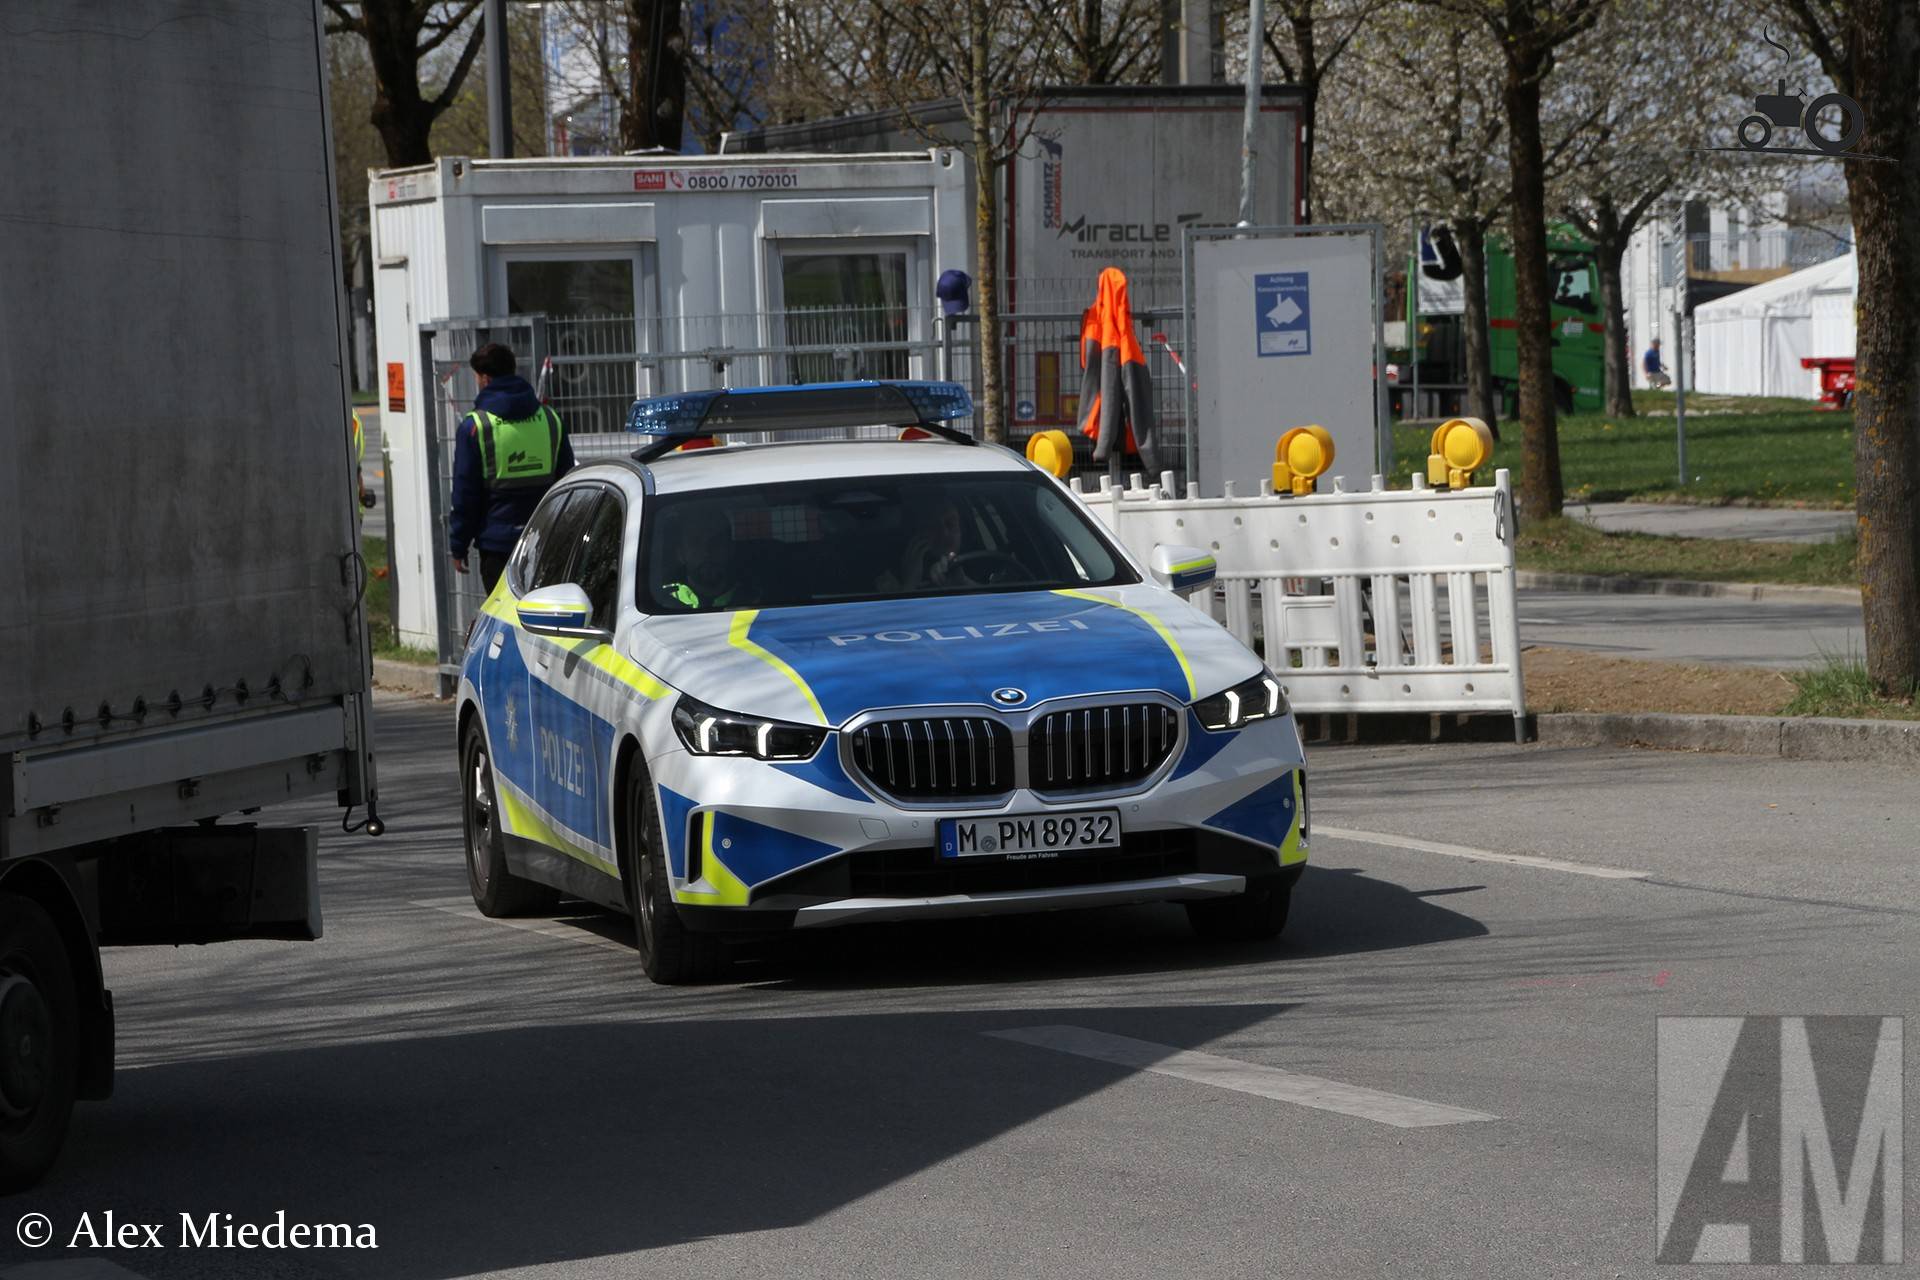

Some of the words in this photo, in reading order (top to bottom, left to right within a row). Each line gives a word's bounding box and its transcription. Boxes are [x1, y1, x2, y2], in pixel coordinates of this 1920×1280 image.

[636, 173, 664, 184] SANI
[1043, 162, 1054, 229] SCHMITZ
[1071, 248, 1144, 259] TRANSPORT
[1149, 248, 1176, 259] AND
[827, 619, 1089, 647] POLIZEI
[541, 726, 586, 799] POLIZEI
[958, 823, 977, 852] M
[999, 820, 1036, 850] PM
[1042, 816, 1114, 847] 8932
